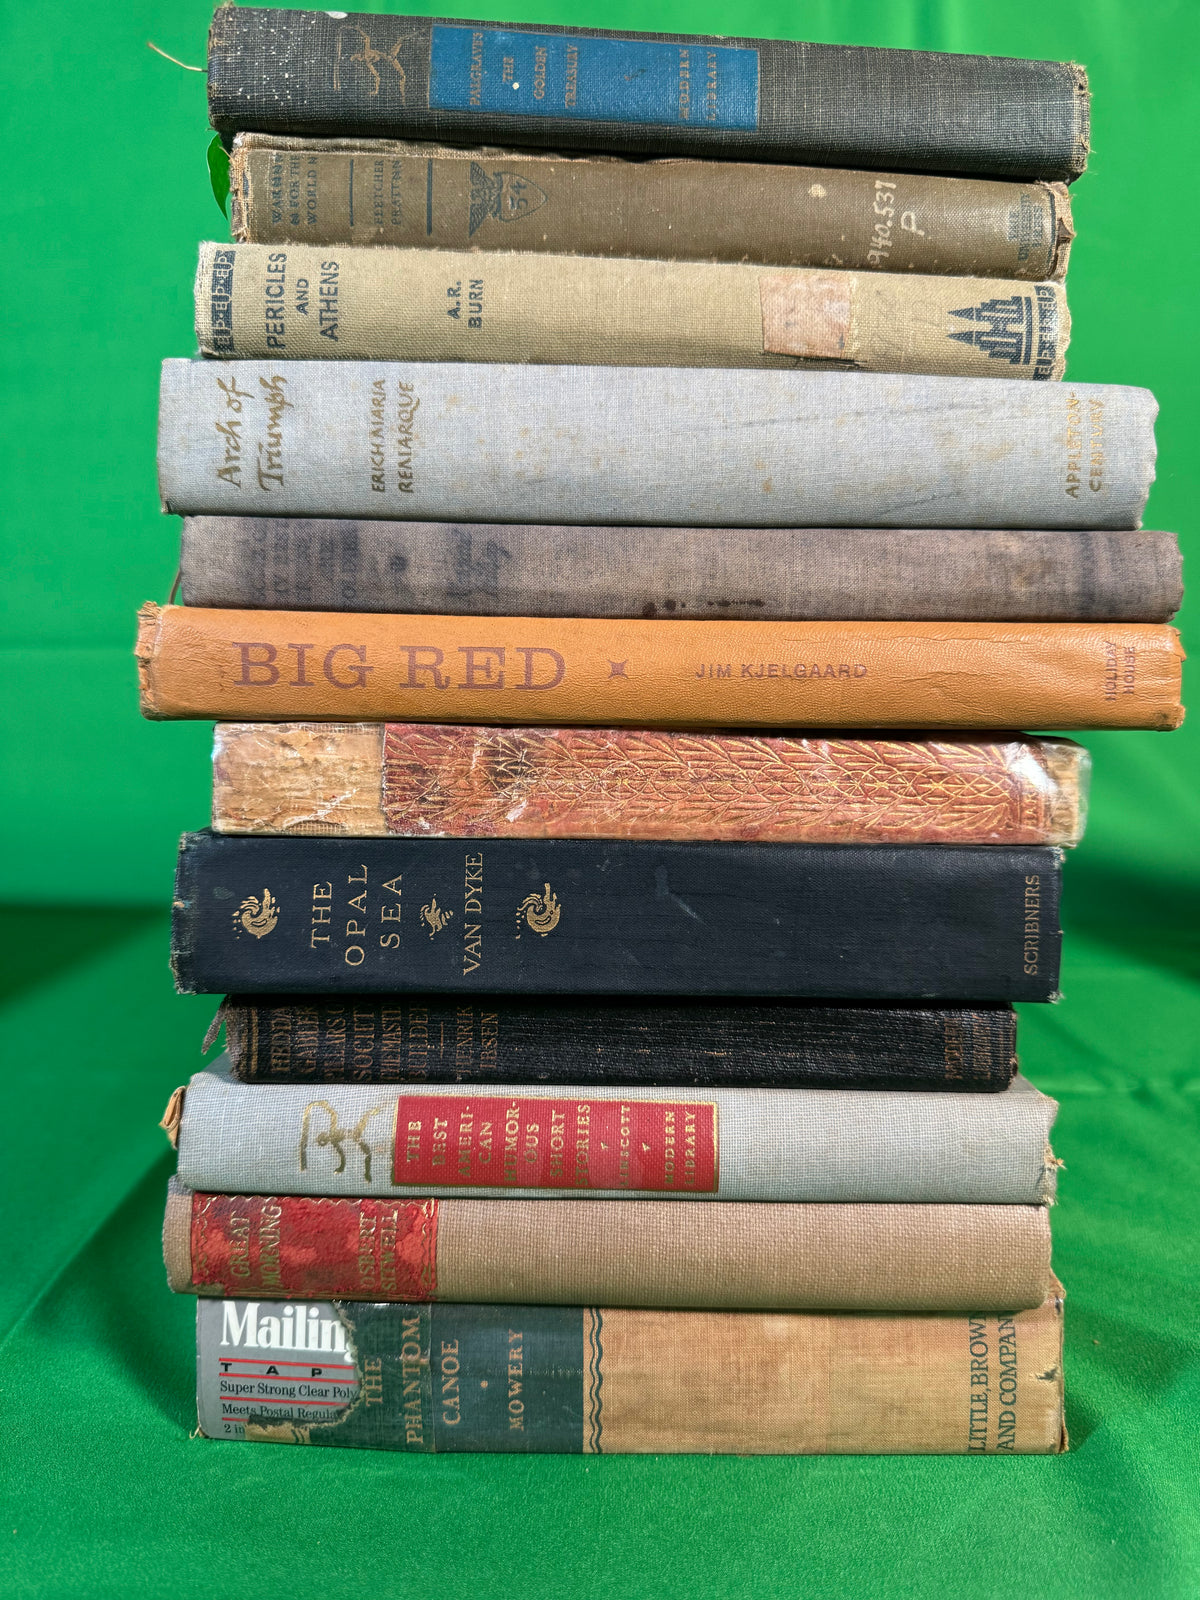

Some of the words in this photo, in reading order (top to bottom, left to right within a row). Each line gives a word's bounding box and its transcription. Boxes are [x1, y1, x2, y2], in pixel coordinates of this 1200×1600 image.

[503, 57, 515, 83] THE
[533, 46, 547, 99] GOLDEN
[565, 44, 578, 108] TREASURY
[679, 49, 690, 120] MODERN
[706, 51, 718, 121] LIBRARY
[373, 160, 384, 225] FLETCHER
[508, 181, 528, 211] 54
[901, 211, 925, 236] P
[266, 252, 287, 350] PERICLES
[296, 278, 309, 315] AND
[319, 261, 339, 342] ATHENS
[447, 281, 461, 319] A.R.
[468, 279, 484, 328] BURN
[217, 376, 255, 413] of
[215, 422, 242, 489] Arch
[257, 375, 295, 491] Triumph
[370, 442, 385, 493] ERICH
[232, 641, 376, 690] BIG
[399, 645, 567, 691] RED
[695, 664, 731, 679] JIM
[740, 664, 868, 679] KJELGAARD
[1104, 641, 1117, 701] HOLIDAY
[1123, 646, 1135, 695] HOUSE
[310, 880, 333, 949] THE
[379, 874, 403, 949] SEA
[463, 851, 484, 915] DYKE
[344, 864, 369, 967] OPAL
[1024, 875, 1040, 976] SCRIBNERS
[462, 923, 482, 976] VAN
[270, 1005, 291, 1074] HEDDA
[353, 1005, 375, 1081] SOCIET
[381, 1004, 402, 1052] MASTE
[456, 1005, 474, 1076] HENRIK
[479, 1011, 499, 1070] IBSEN
[407, 1120, 422, 1163] THE
[432, 1117, 448, 1166] BEST
[478, 1121, 493, 1164] CAN
[524, 1122, 539, 1163] OUS
[550, 1109, 565, 1177] SHORT
[575, 1104, 590, 1185] STORIES
[620, 1105, 630, 1186] LINSCOTT
[665, 1110, 675, 1184] MODERN
[685, 1110, 696, 1185] LIBRARY
[230, 1210, 250, 1278] GREAT
[259, 1203, 282, 1288] MORNING
[358, 1211, 377, 1288] OSBERT
[380, 1209, 398, 1291] SITWELL
[220, 1380, 255, 1395] Super
[257, 1382, 296, 1398] Strong
[298, 1384, 329, 1398] Clear
[364, 1356, 383, 1407] THE
[401, 1315, 424, 1444] PHANTOM
[441, 1339, 461, 1425] CANOE
[508, 1328, 524, 1432] MOWERY
[998, 1313, 1018, 1406] COMPAN
[222, 1403, 256, 1416] Meets
[260, 1406, 294, 1418] Postal
[224, 1423, 232, 1434] 2
[968, 1388, 991, 1452] LITTLE,
[996, 1410, 1016, 1451] AND
